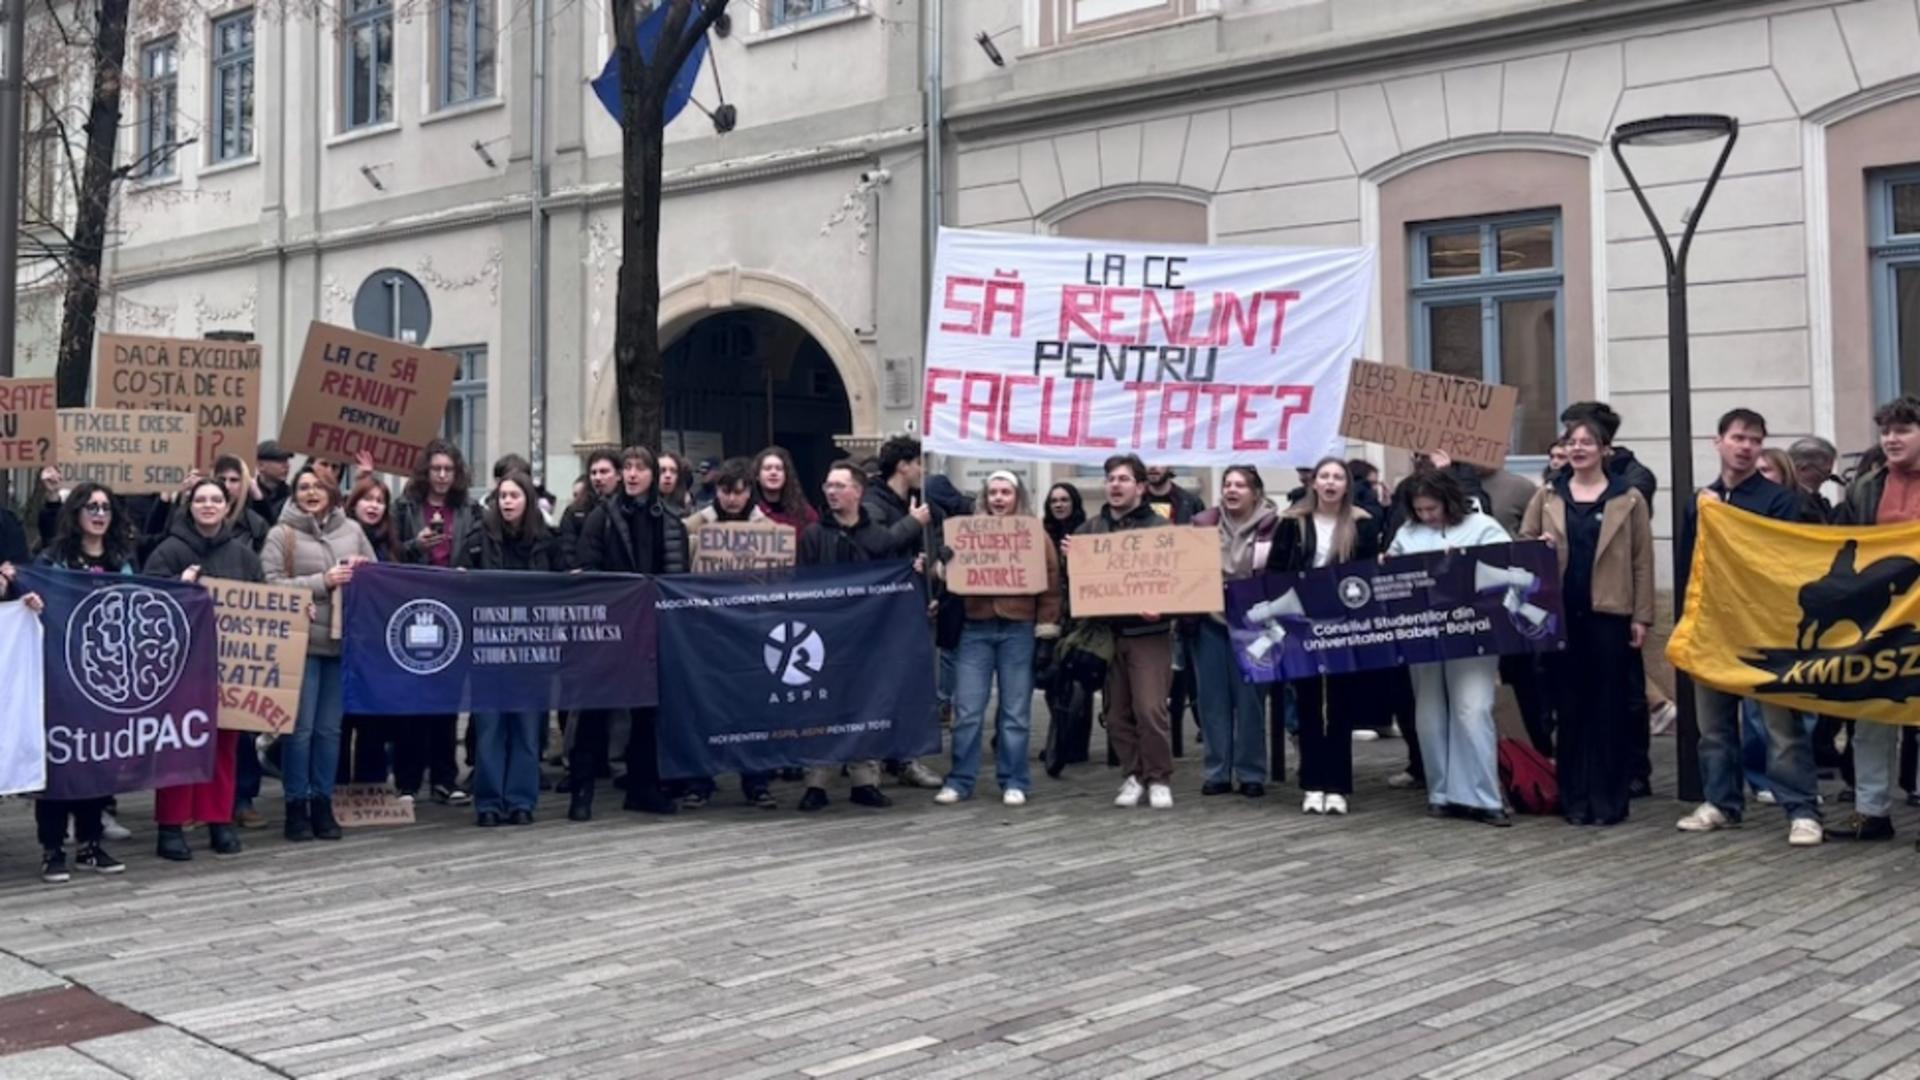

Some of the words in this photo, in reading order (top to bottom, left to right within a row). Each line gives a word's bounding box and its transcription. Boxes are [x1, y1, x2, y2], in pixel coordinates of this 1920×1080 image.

[1085, 253, 1126, 286] LA
[1143, 256, 1188, 289] CE
[940, 268, 1025, 338] SĂ
[323, 343, 351, 366] LA
[355, 351, 378, 372] CE
[1034, 340, 1218, 383] PENTRU
[195, 373, 218, 397] DE
[223, 377, 246, 397] CE
[1353, 362, 1397, 392] UBB
[1407, 371, 1494, 410] PENTRU
[58, 412, 131, 432] TAXELE
[339, 406, 401, 435] PENTRU
[922, 368, 1314, 450] FACULTATE?
[1447, 407, 1480, 431] NU
[307, 421, 424, 469] FACULTAT
[1347, 413, 1431, 449] PENTRU
[151, 440, 169, 454] LA
[1093, 539, 1111, 554] LA
[1121, 534, 1143, 551] CE
[212, 588, 301, 613] LCULELE
[215, 614, 291, 639] OASTRE
[1312, 619, 1372, 637] Consiliul
[1451, 606, 1475, 621] din
[1781, 643, 1920, 684] KMDSZ
[769, 688, 829, 703] ASPR
[47, 709, 210, 764] StudPAC
